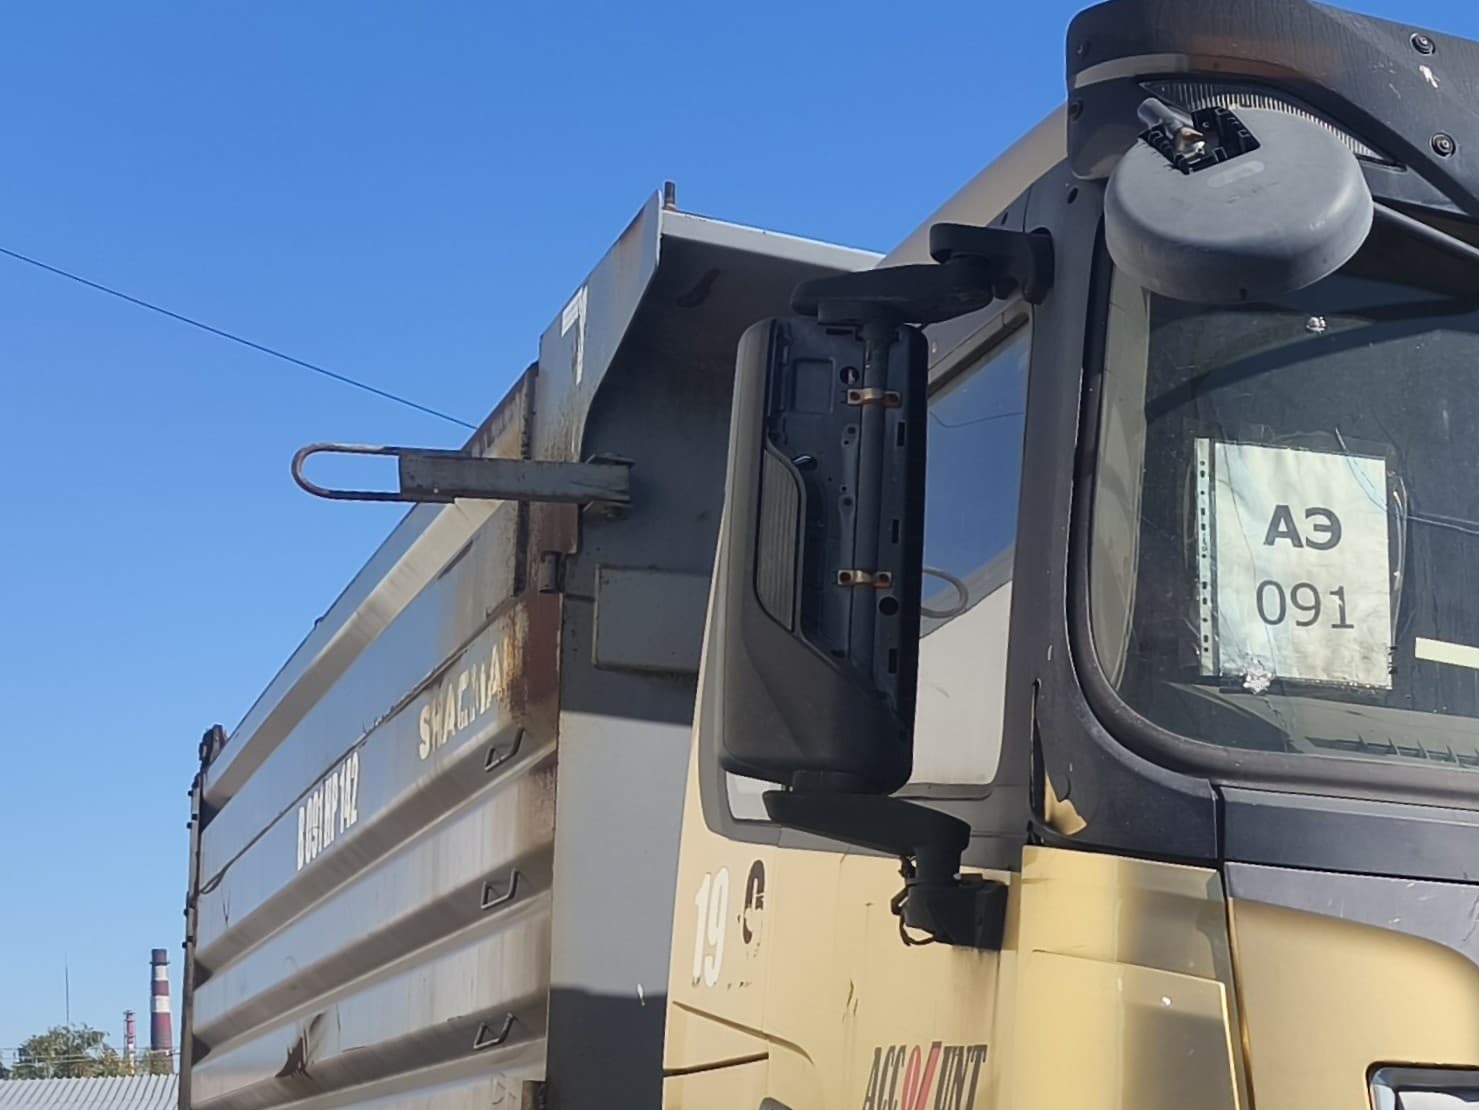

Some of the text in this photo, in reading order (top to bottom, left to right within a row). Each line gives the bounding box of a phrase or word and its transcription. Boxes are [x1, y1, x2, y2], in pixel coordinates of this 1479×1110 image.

[1264, 504, 1341, 551] АЭ
[1256, 579, 1354, 630] 091
[691, 865, 729, 987] 19
